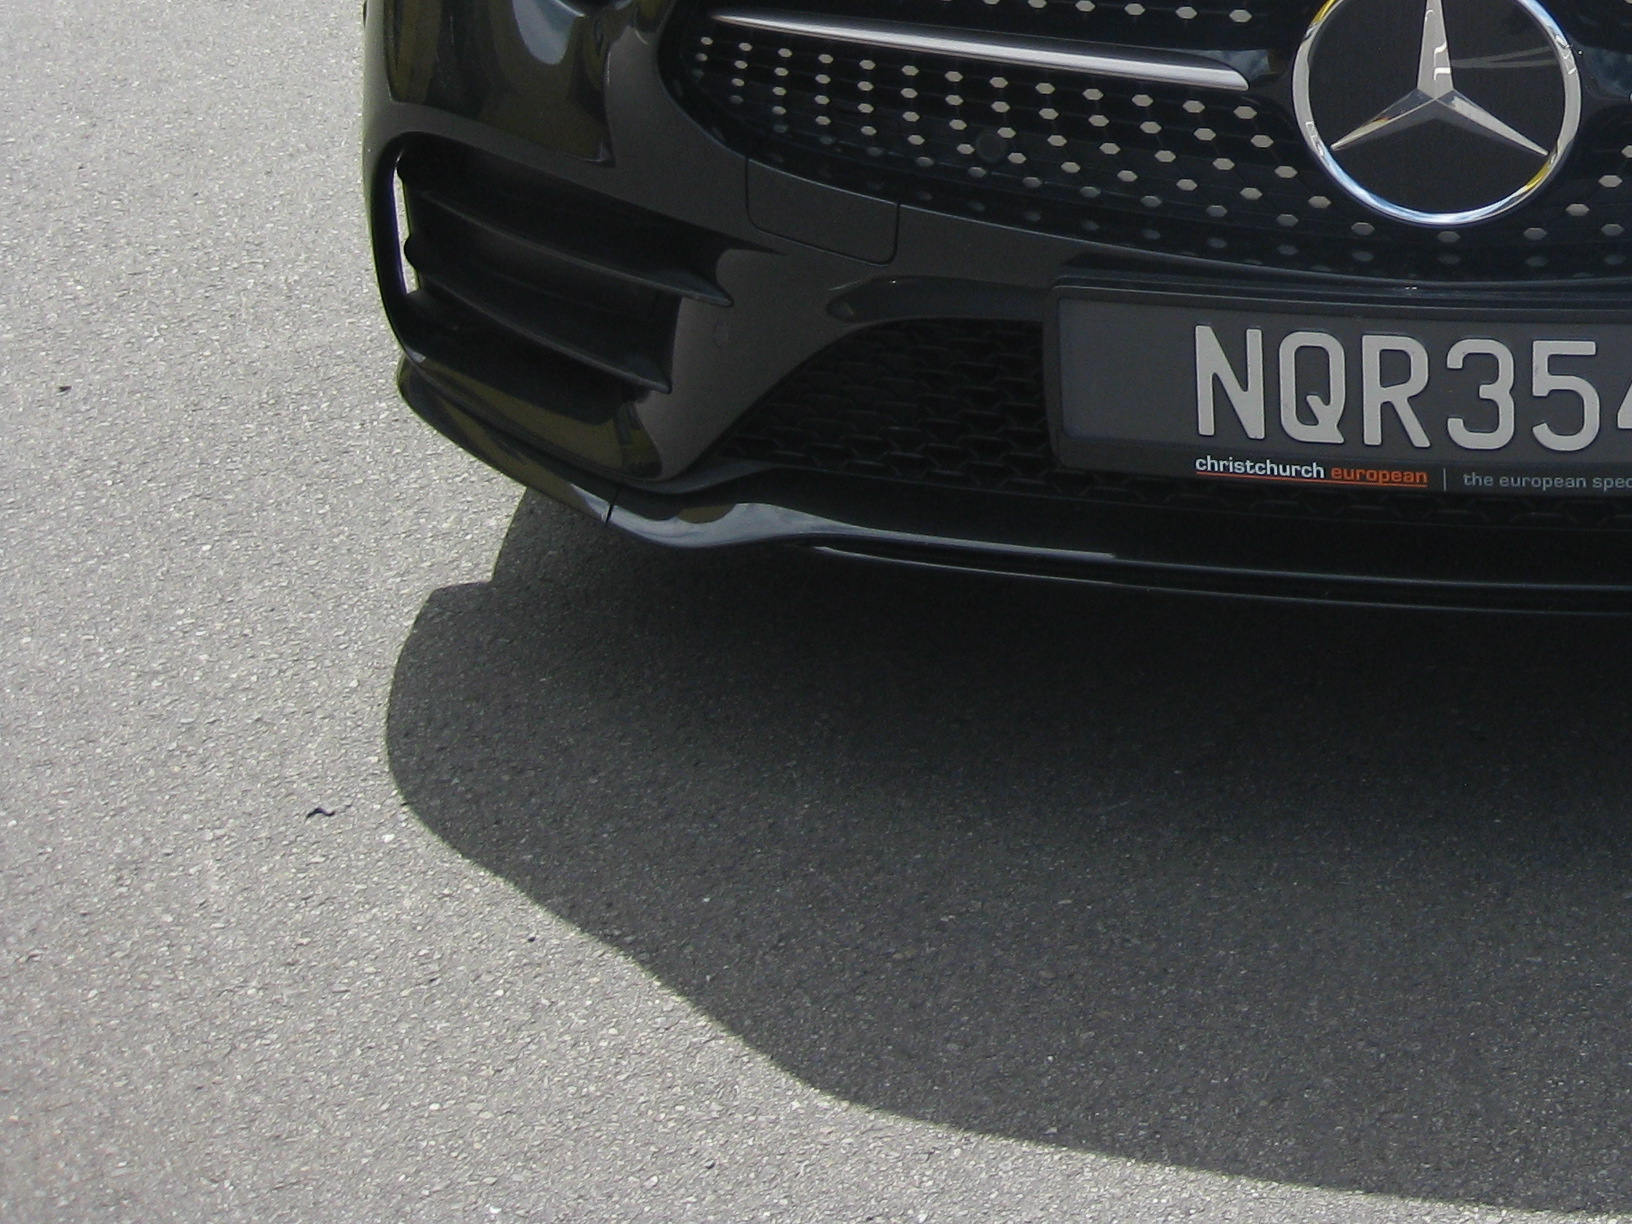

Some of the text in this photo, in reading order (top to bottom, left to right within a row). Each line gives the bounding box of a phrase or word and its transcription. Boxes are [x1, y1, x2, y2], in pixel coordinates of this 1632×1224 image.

[1195, 455, 1428, 484] christchurch european
[1463, 472, 1494, 487] the
[1499, 474, 1587, 491] european
